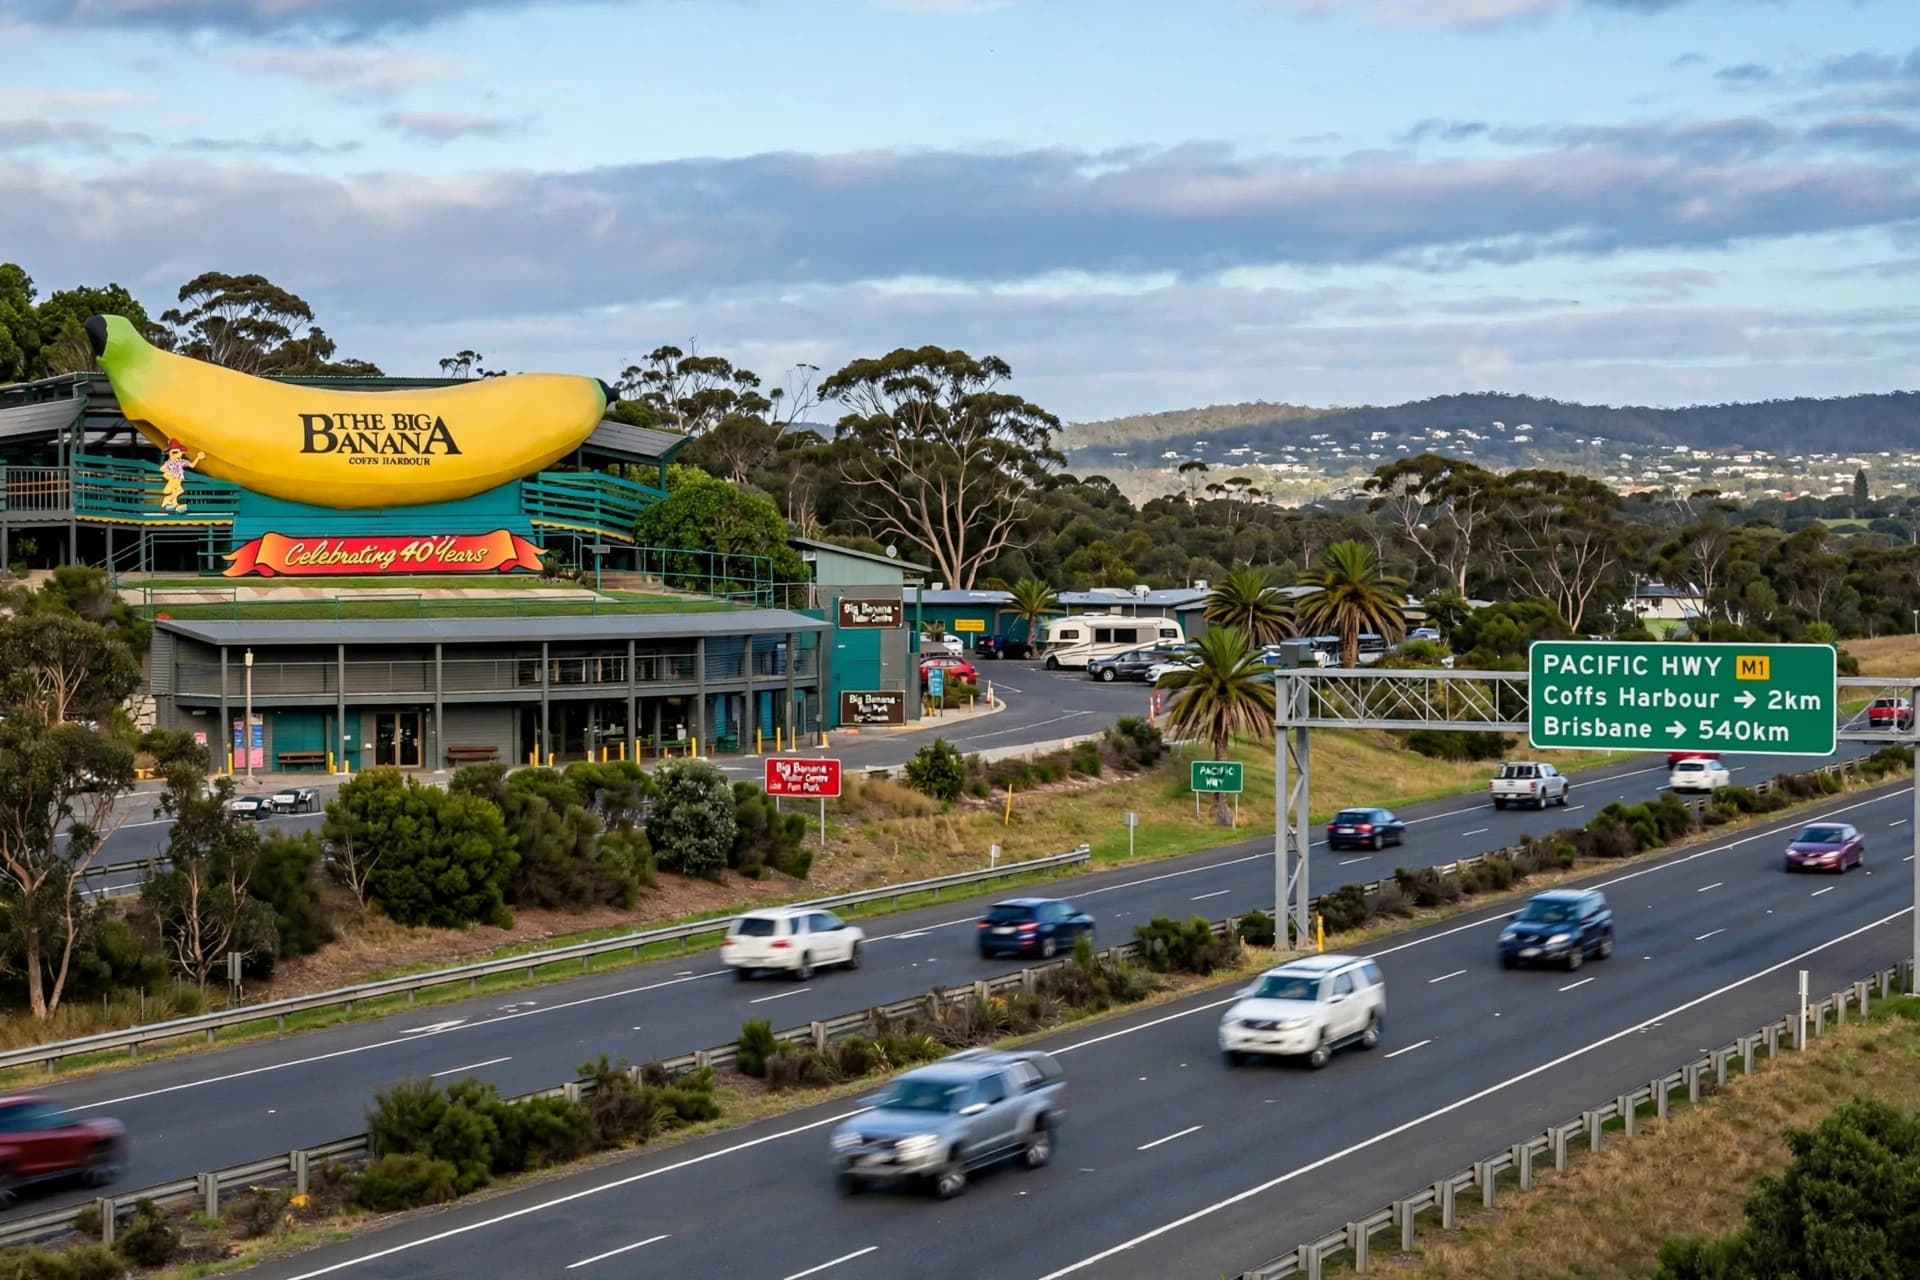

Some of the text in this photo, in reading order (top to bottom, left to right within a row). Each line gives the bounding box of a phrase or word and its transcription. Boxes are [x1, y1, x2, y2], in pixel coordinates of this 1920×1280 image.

[298, 413, 463, 455] BANANA
[333, 413, 432, 432] THE BIG
[285, 538, 488, 570] Celebrating 40 Years
[1543, 654, 1765, 677] PACIFIC HWY M1
[1543, 685, 1821, 711] Coffs Harbour 2km
[1543, 715, 1790, 742] Brisbane 540km
